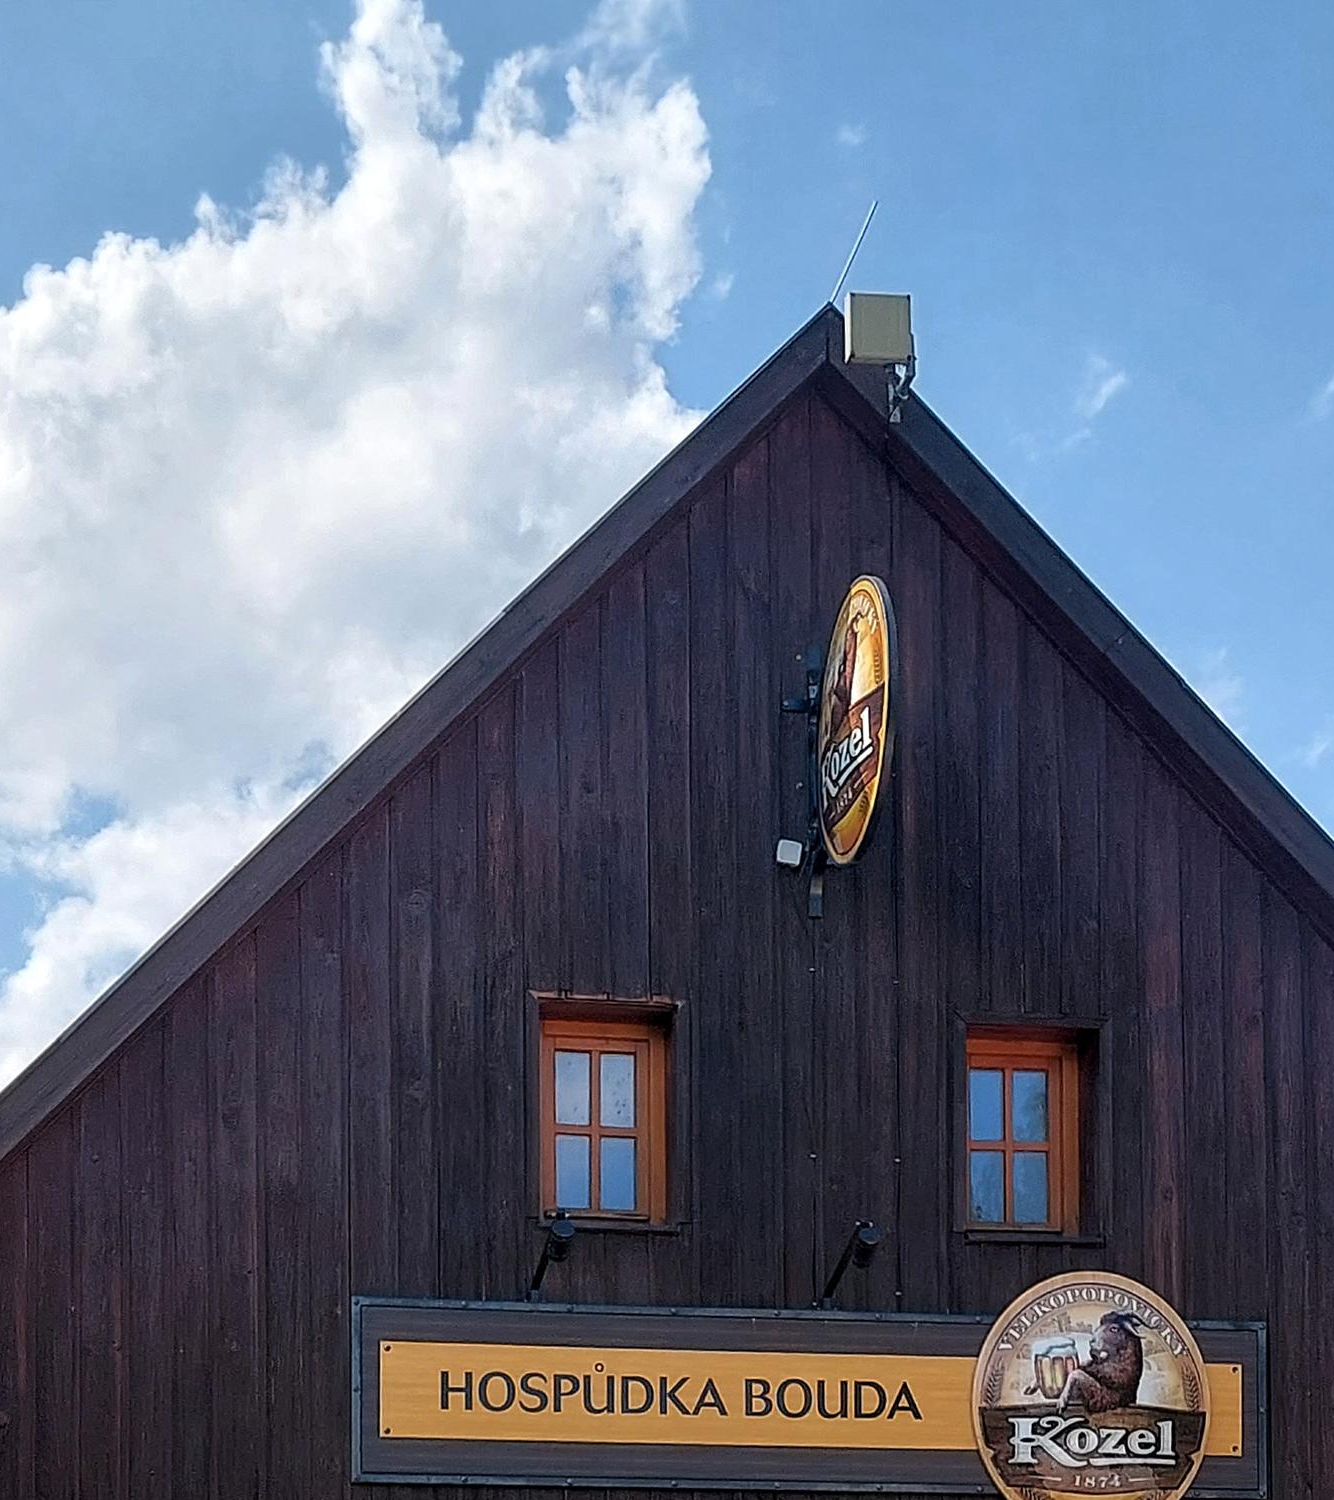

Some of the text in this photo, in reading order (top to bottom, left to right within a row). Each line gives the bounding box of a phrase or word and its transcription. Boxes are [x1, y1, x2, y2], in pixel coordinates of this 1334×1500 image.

[821, 706, 873, 810] Kozel
[439, 1362, 924, 1420] HOSPŮDKA BOUDA
[1008, 1414, 1177, 1468] Kozel
[1073, 1473, 1122, 1489] 1874
